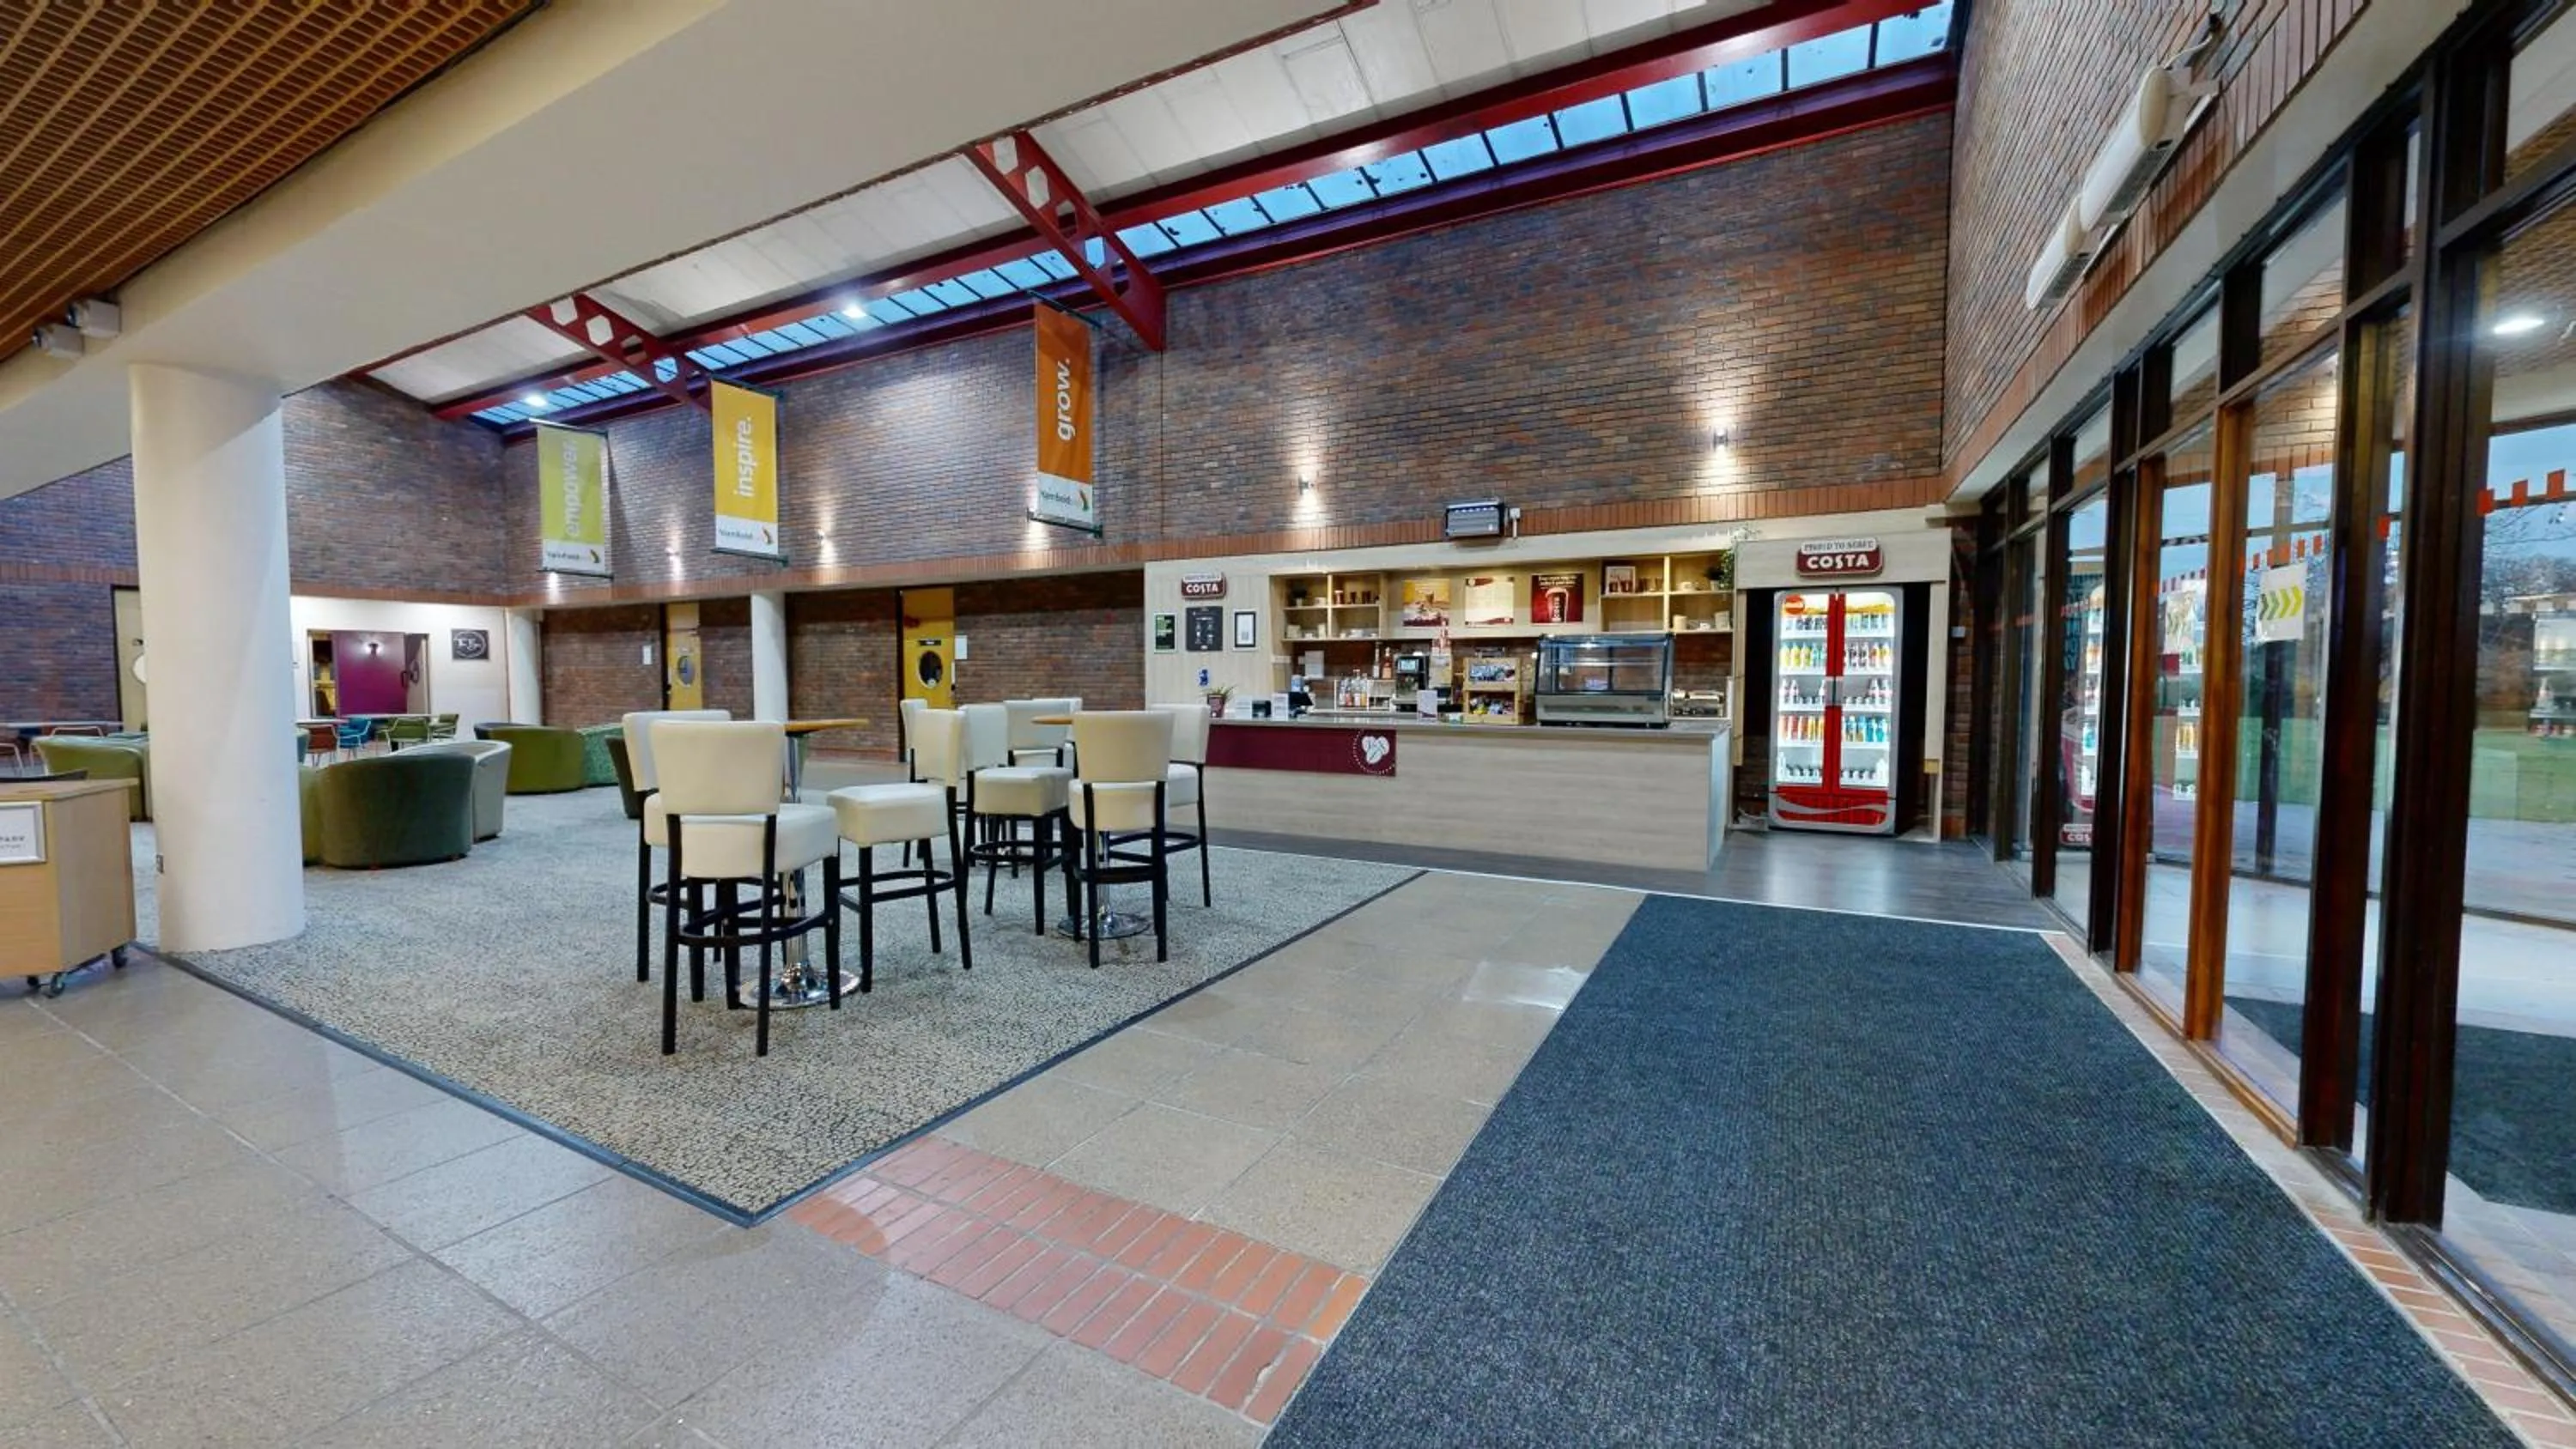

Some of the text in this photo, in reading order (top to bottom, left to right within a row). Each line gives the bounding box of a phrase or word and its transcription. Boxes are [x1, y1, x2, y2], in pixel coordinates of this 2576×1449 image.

[1057, 358, 1076, 440] grow.
[734, 416, 756, 497] inspire.
[1807, 554, 1869, 569] COSTA
[1186, 584, 1218, 593] COSTA
